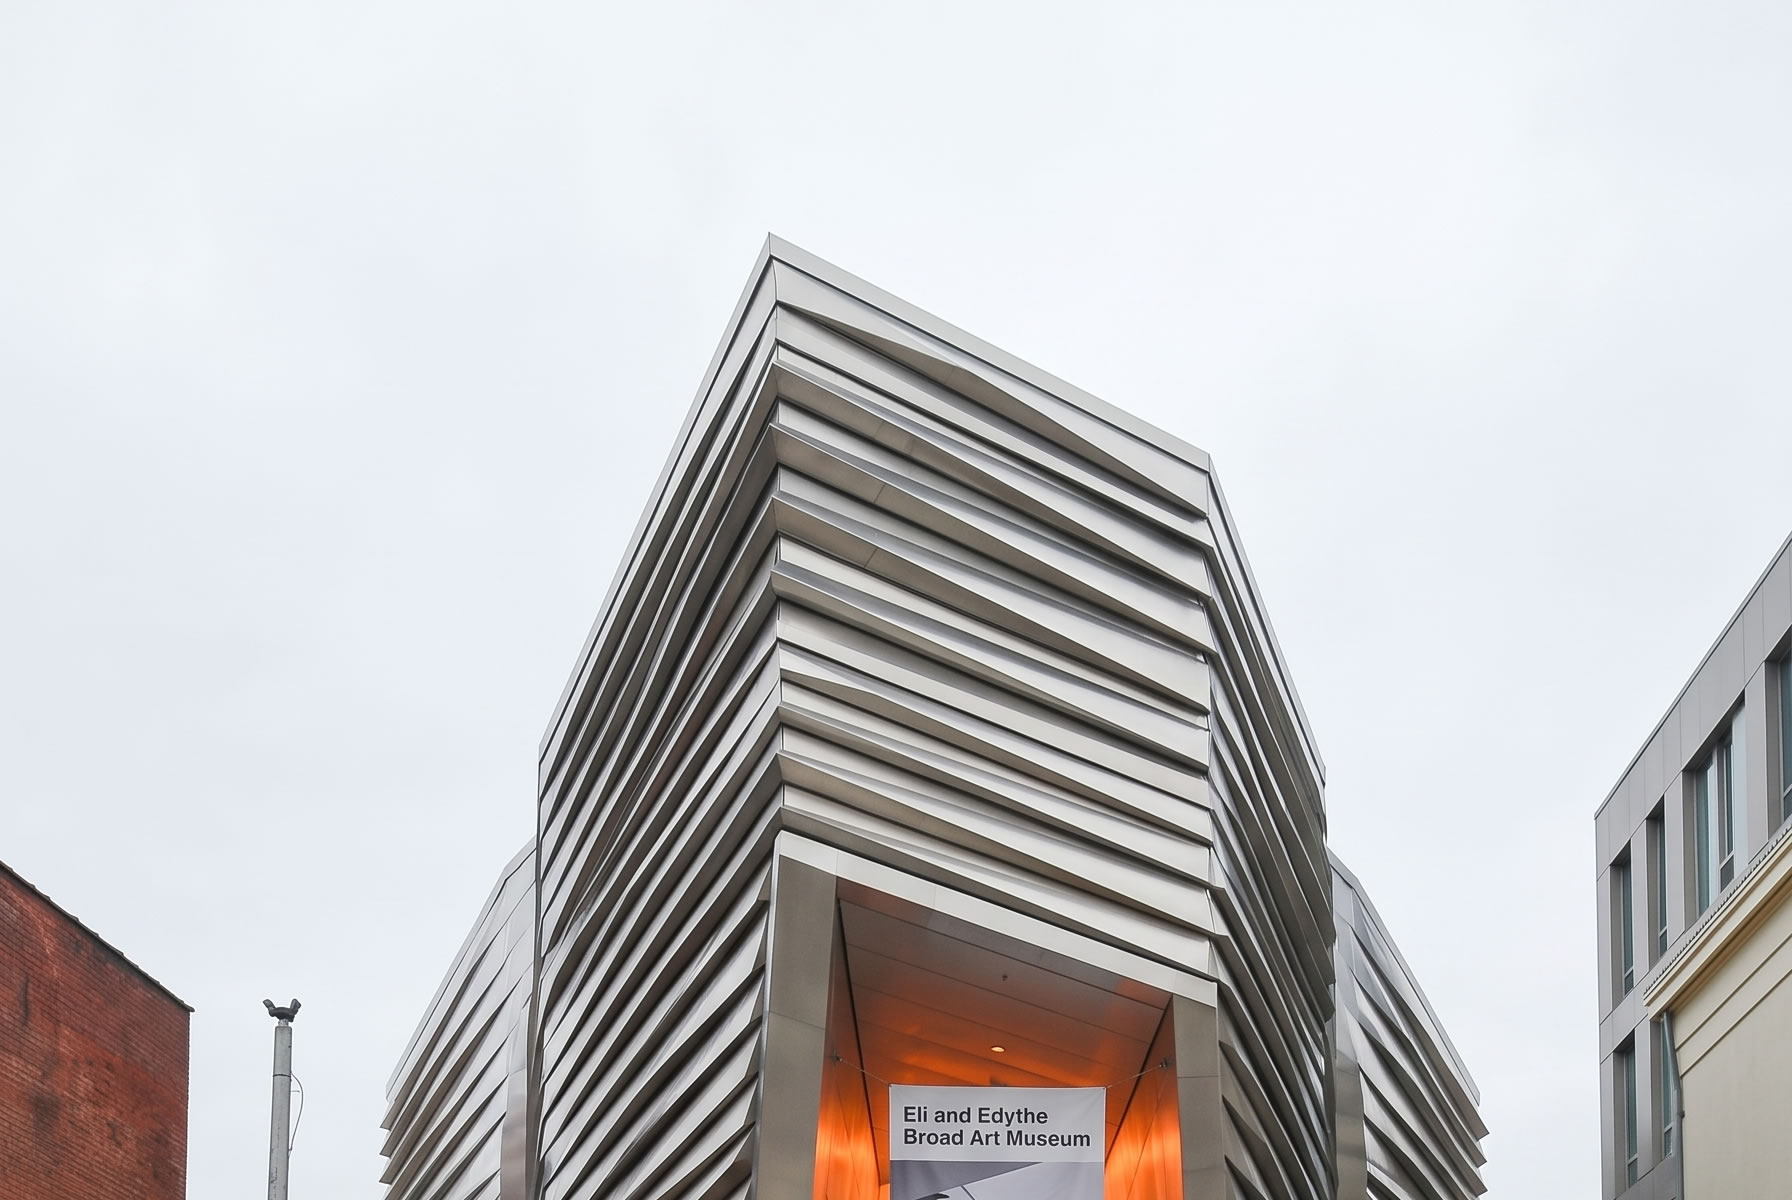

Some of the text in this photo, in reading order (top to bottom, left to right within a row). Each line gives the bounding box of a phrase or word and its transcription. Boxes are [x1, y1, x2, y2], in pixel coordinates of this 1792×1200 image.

[903, 1105, 1049, 1127] Eli and Edythe
[903, 1128, 1091, 1147] Broad Art Museum
